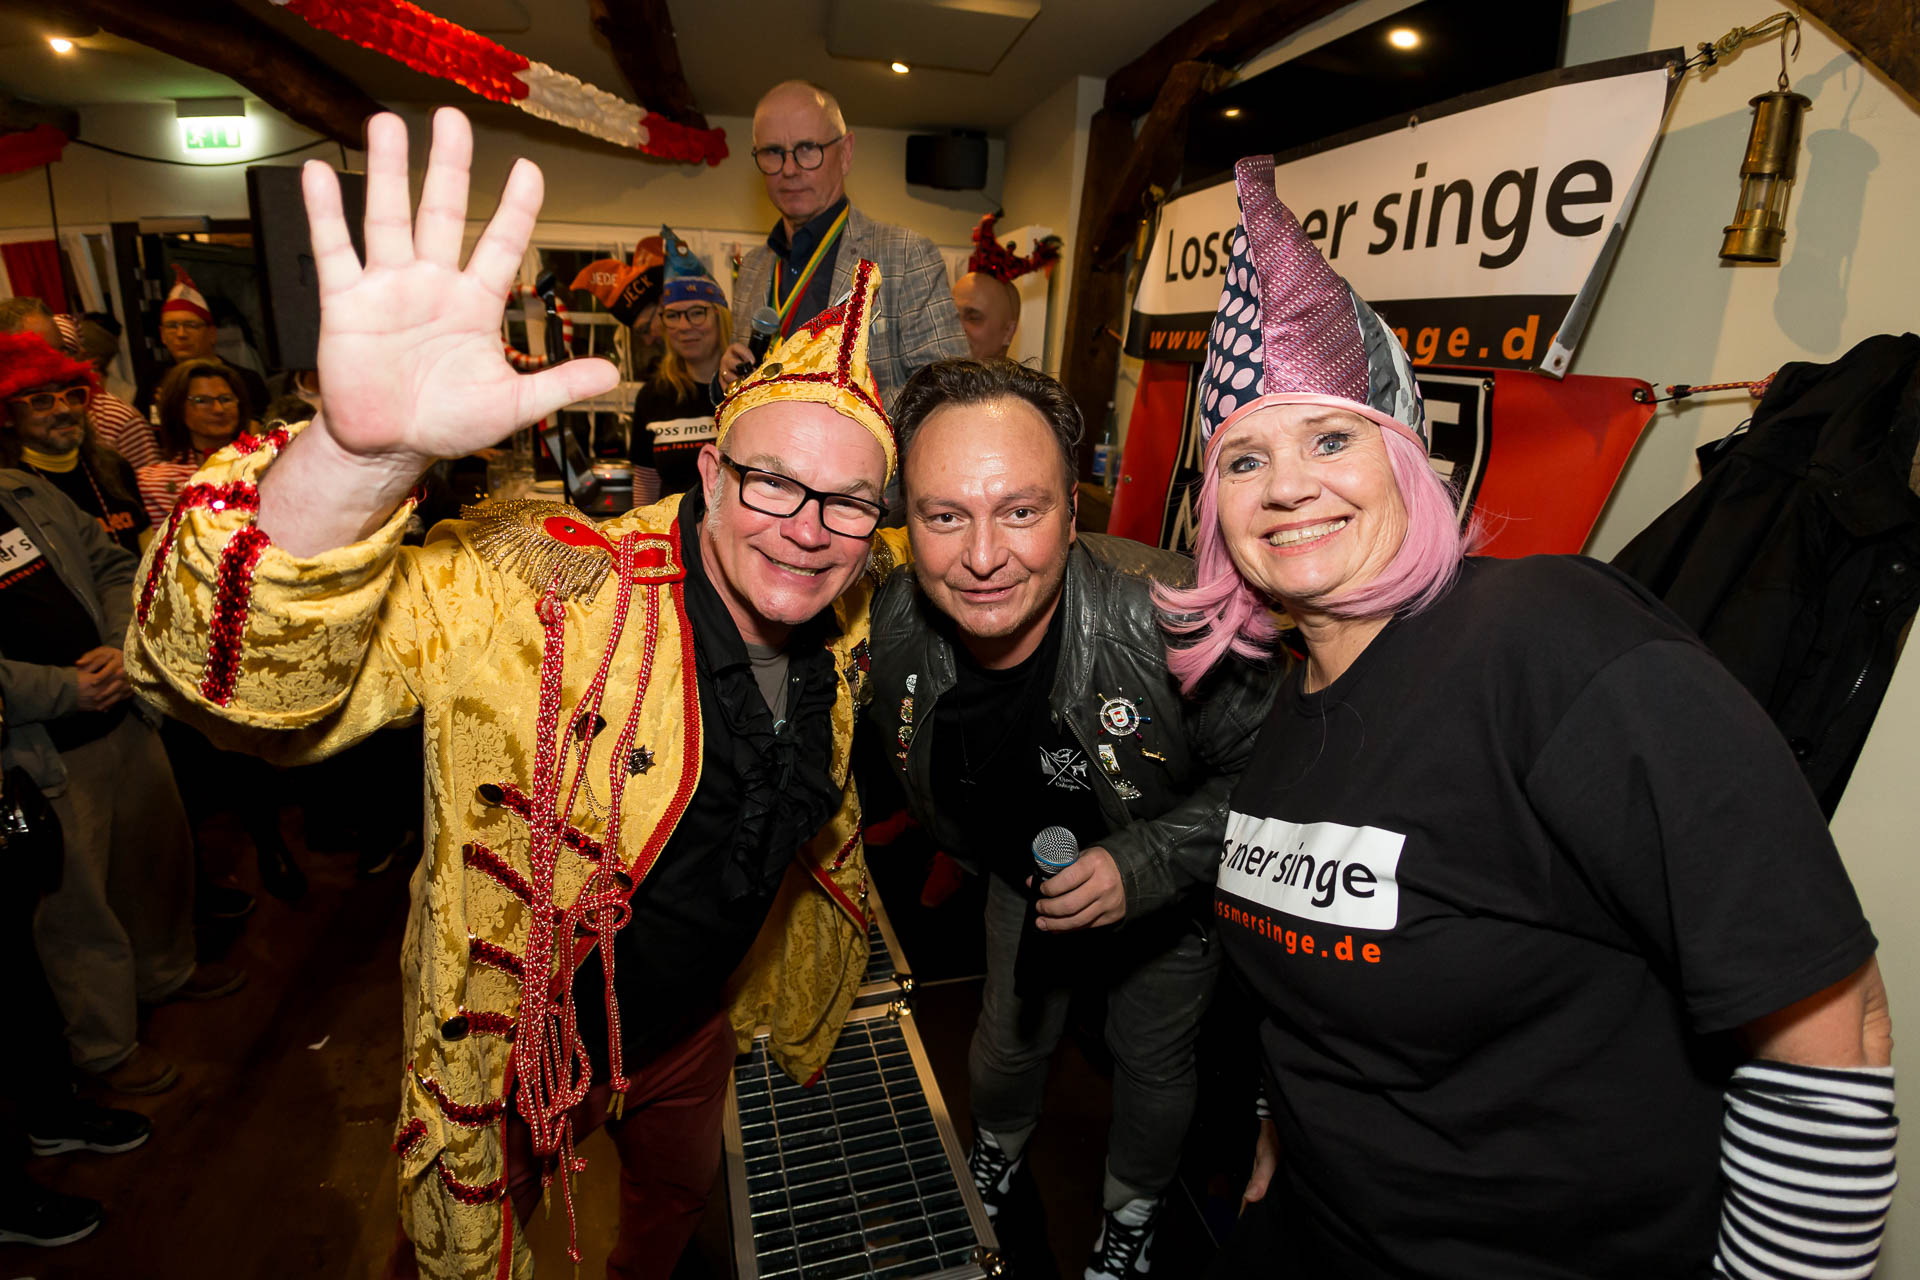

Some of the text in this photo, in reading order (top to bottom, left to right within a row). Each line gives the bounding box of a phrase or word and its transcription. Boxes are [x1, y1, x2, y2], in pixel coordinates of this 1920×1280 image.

[1368, 159, 1613, 270] singe
[622, 275, 654, 308] JECK
[655, 424, 715, 436] oss mer
[1272, 842, 1378, 909] singe
